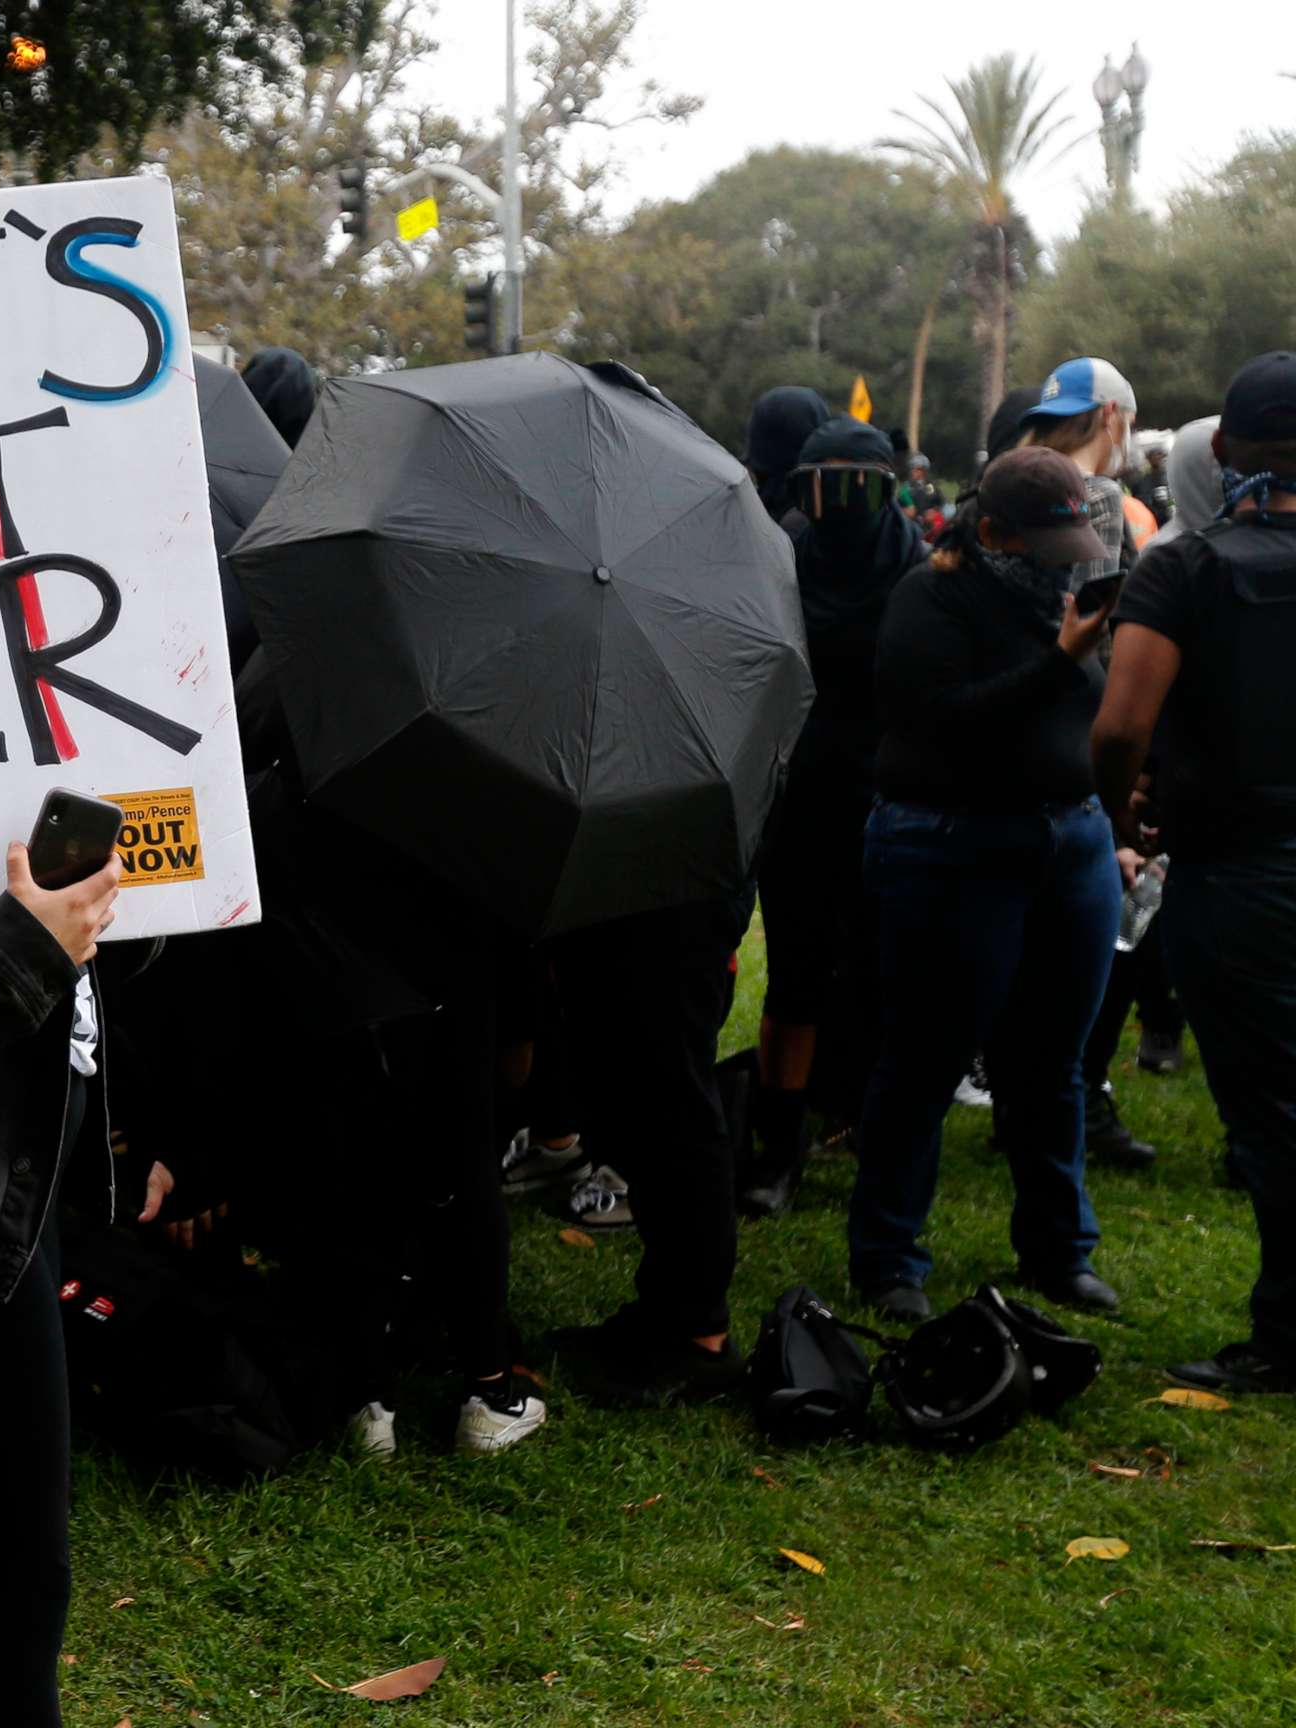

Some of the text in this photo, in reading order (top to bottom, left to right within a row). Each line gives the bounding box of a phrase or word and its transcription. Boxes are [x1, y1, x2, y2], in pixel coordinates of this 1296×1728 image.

[125, 804, 191, 822] mp/Pence
[118, 820, 185, 849] OUT
[118, 844, 198, 874] NOW
